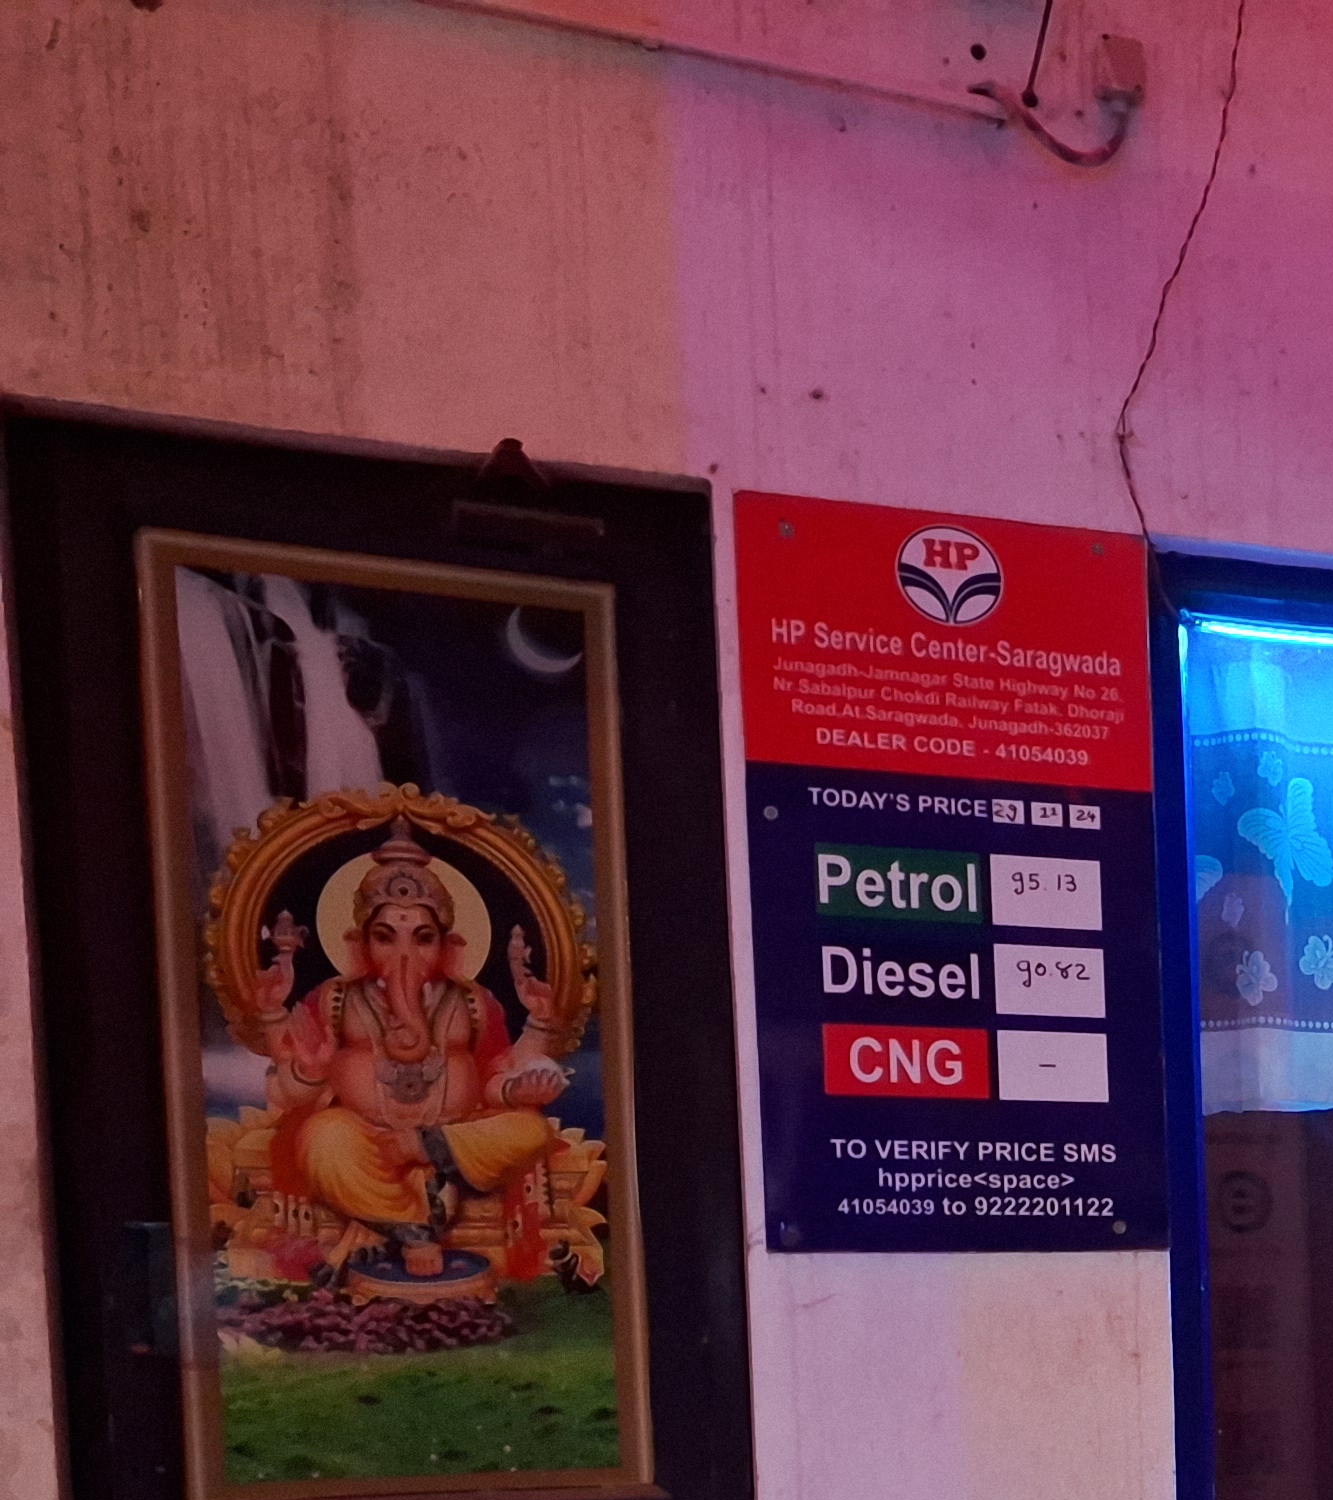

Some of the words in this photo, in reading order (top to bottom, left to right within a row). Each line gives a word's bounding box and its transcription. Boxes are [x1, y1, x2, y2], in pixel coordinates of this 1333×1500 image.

[921, 537, 980, 571] HP
[771, 617, 805, 644] HP
[814, 621, 902, 655] Service
[911, 631, 1121, 677] Center-Saragwada
[953, 672, 994, 689] State
[1000, 677, 1068, 700] Highway
[881, 686, 939, 705] Chokdi
[945, 692, 1010, 715] Railway
[1068, 703, 1124, 724] Dhoraji
[968, 715, 1109, 740] Junagadh-362037
[816, 727, 907, 751] DEALER
[914, 736, 976, 757] CODE
[995, 742, 1089, 766] 41054039
[807, 786, 911, 813] TODAY'S
[918, 797, 988, 818] PRICE
[1075, 809, 1096, 823] 24
[817, 853, 979, 913] Petrol
[821, 945, 981, 1000] Diesel
[848, 1036, 964, 1086] CNG
[830, 1138, 867, 1159] TO
[874, 1140, 970, 1161] VERIFY
[978, 1142, 1055, 1163] PRICE
[1063, 1143, 1117, 1164] SMS
[877, 1168, 1076, 1192] hpprice<space>
[837, 1197, 935, 1216] 41054039
[942, 1197, 967, 1216] to
[974, 1197, 1115, 1217] 9222201122
